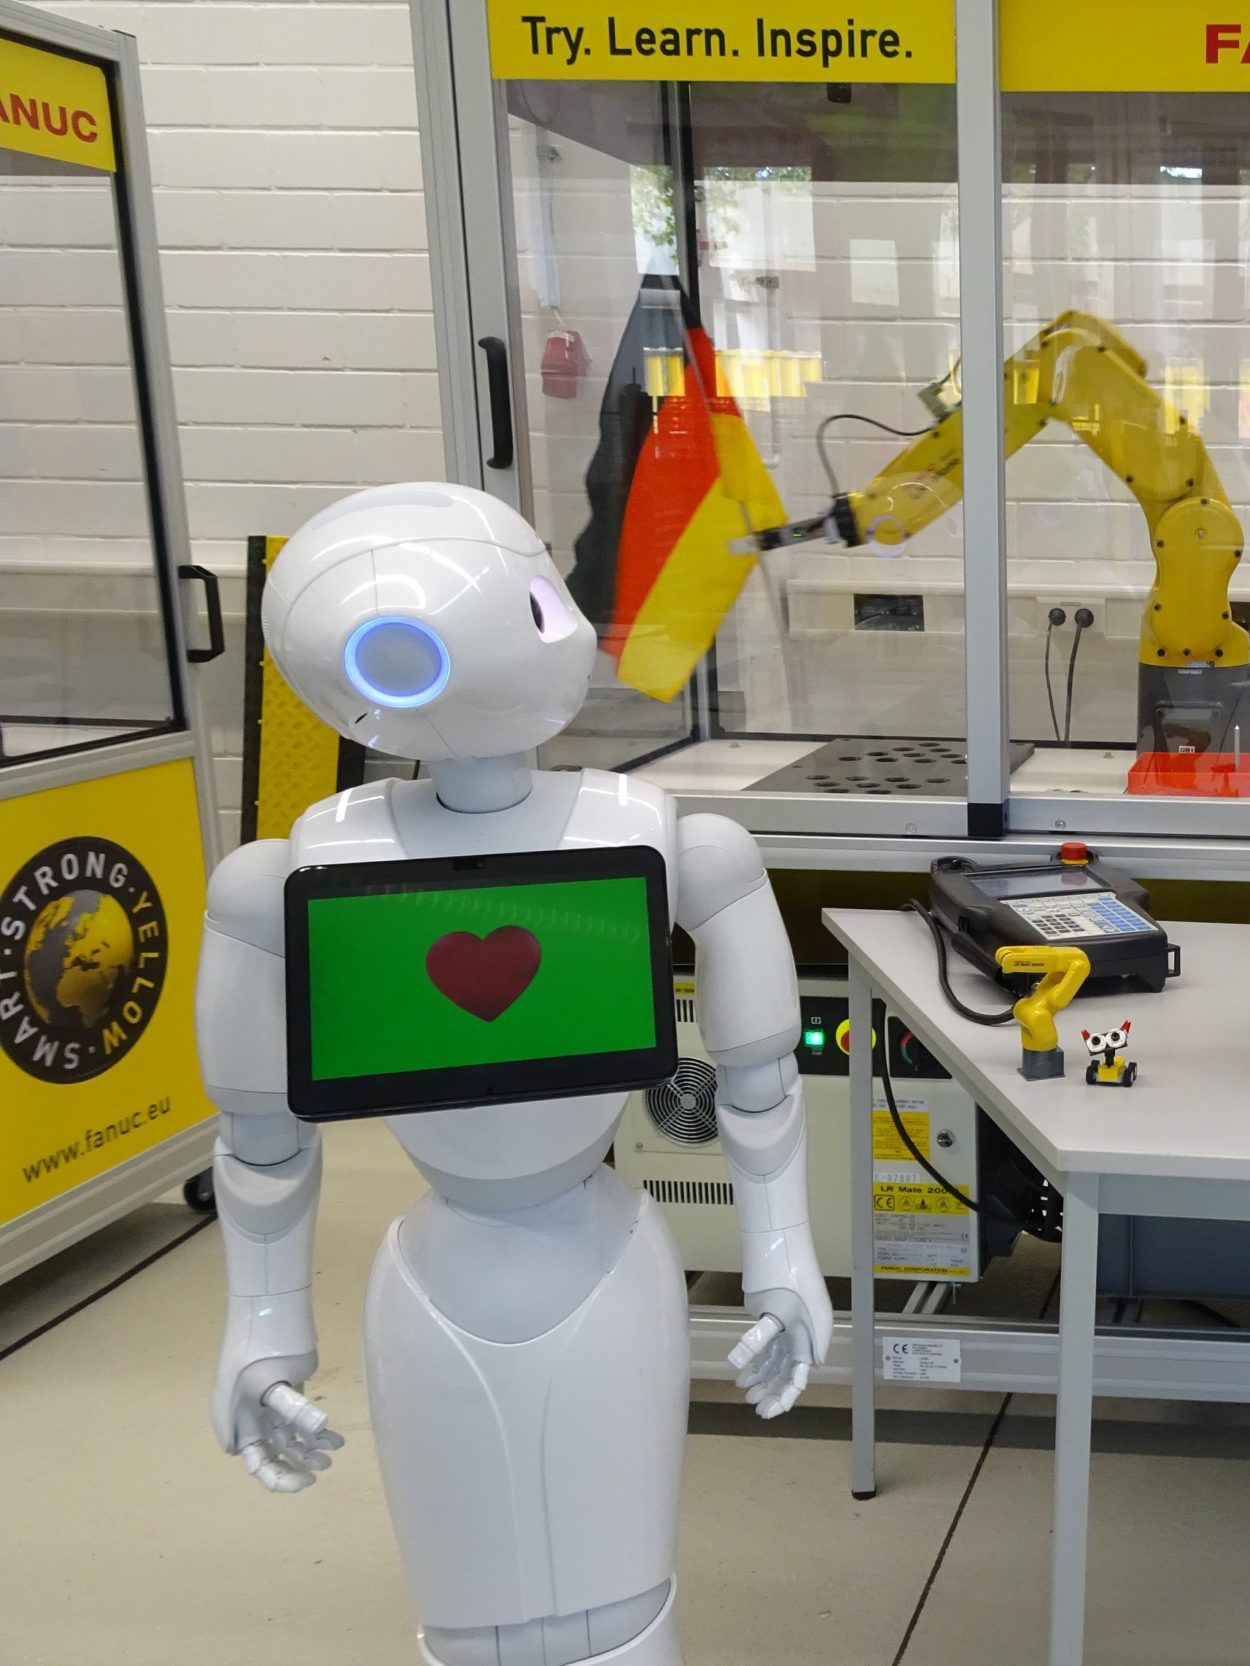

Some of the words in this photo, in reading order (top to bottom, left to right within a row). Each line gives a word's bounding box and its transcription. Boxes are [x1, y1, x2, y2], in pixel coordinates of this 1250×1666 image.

[521, 15, 591, 65] Try.
[608, 16, 739, 58] Learn.
[756, 18, 912, 68] Inspire.
[1, 851, 128, 940] STRONG
[101, 890, 159, 1055] YELLOW
[22, 1096, 171, 1183] www.fanuc.eu
